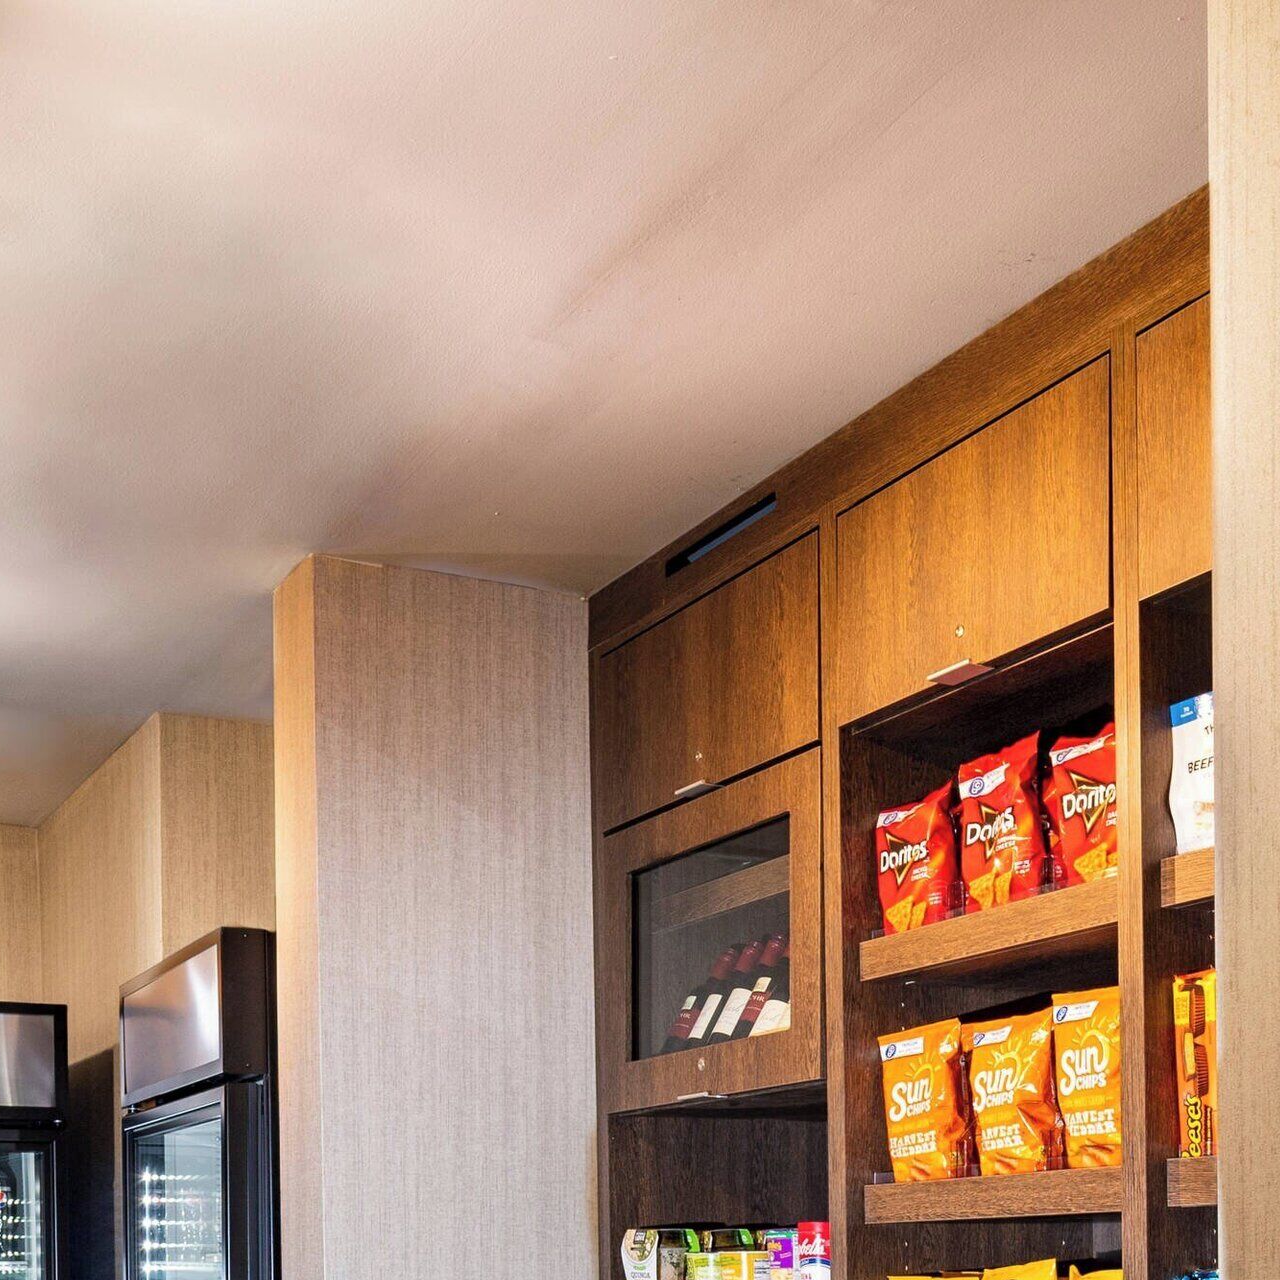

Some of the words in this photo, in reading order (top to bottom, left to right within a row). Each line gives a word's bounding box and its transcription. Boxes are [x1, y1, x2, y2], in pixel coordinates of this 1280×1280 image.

[1187, 756, 1214, 774] BEEF
[880, 839, 929, 873] Doritos
[1060, 1045, 1109, 1096] Sun
[972, 1065, 1019, 1113] Sun
[1074, 1074, 1107, 1090] CHIPS
[889, 1076, 932, 1122] Sun
[986, 1090, 1015, 1106] CHIPS
[906, 1102, 932, 1117] CHIPS
[889, 1130, 937, 1149] HARVEST
[982, 1123, 1021, 1141] ARVEST
[891, 1142, 937, 1159] CHEDDAR
